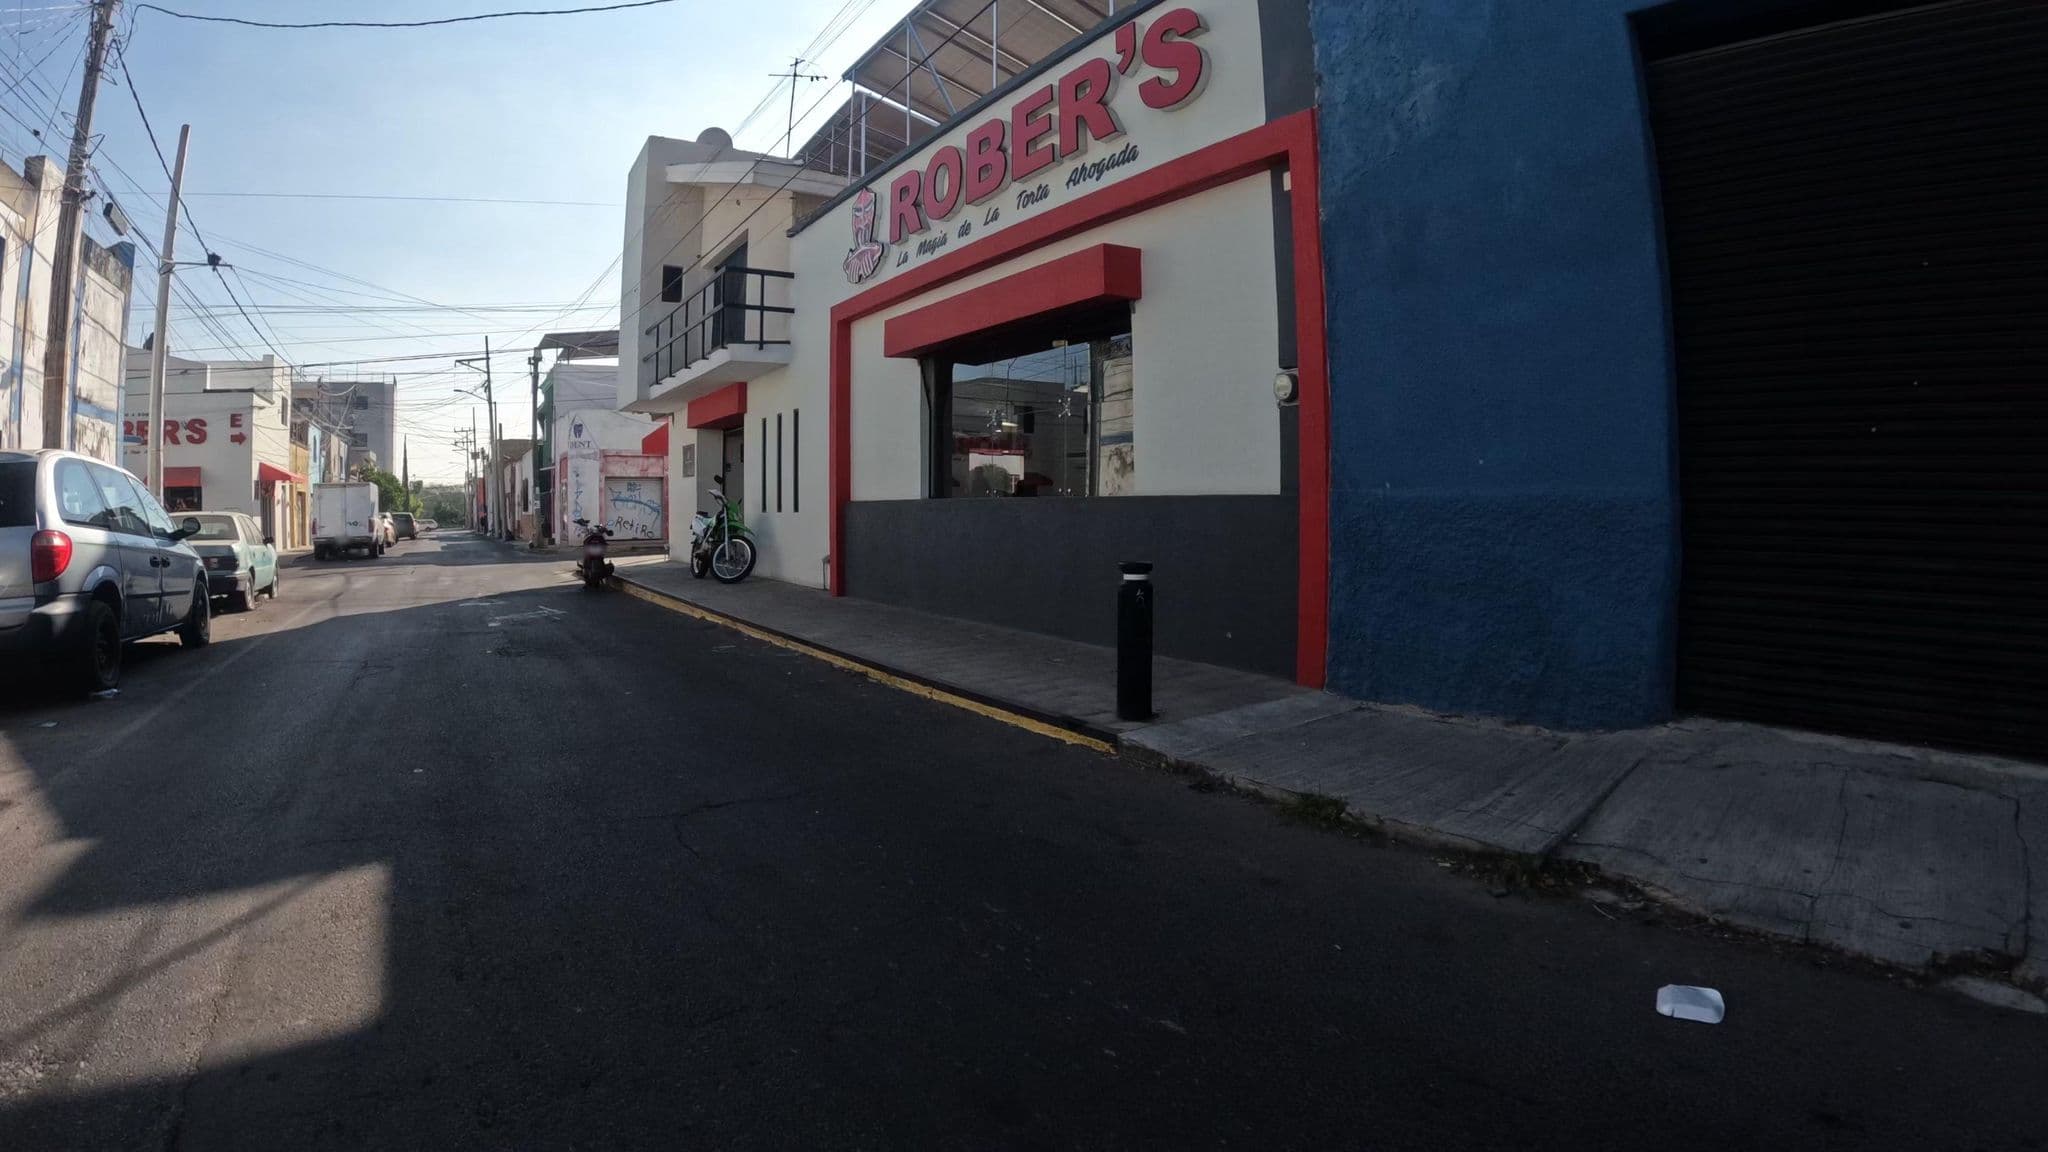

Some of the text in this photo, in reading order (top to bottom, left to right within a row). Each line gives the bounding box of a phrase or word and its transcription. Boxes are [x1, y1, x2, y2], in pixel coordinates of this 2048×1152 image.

[890, 8, 1205, 246] ROBER'S
[896, 142, 1139, 268] La Magia de La Torta Ahogada
